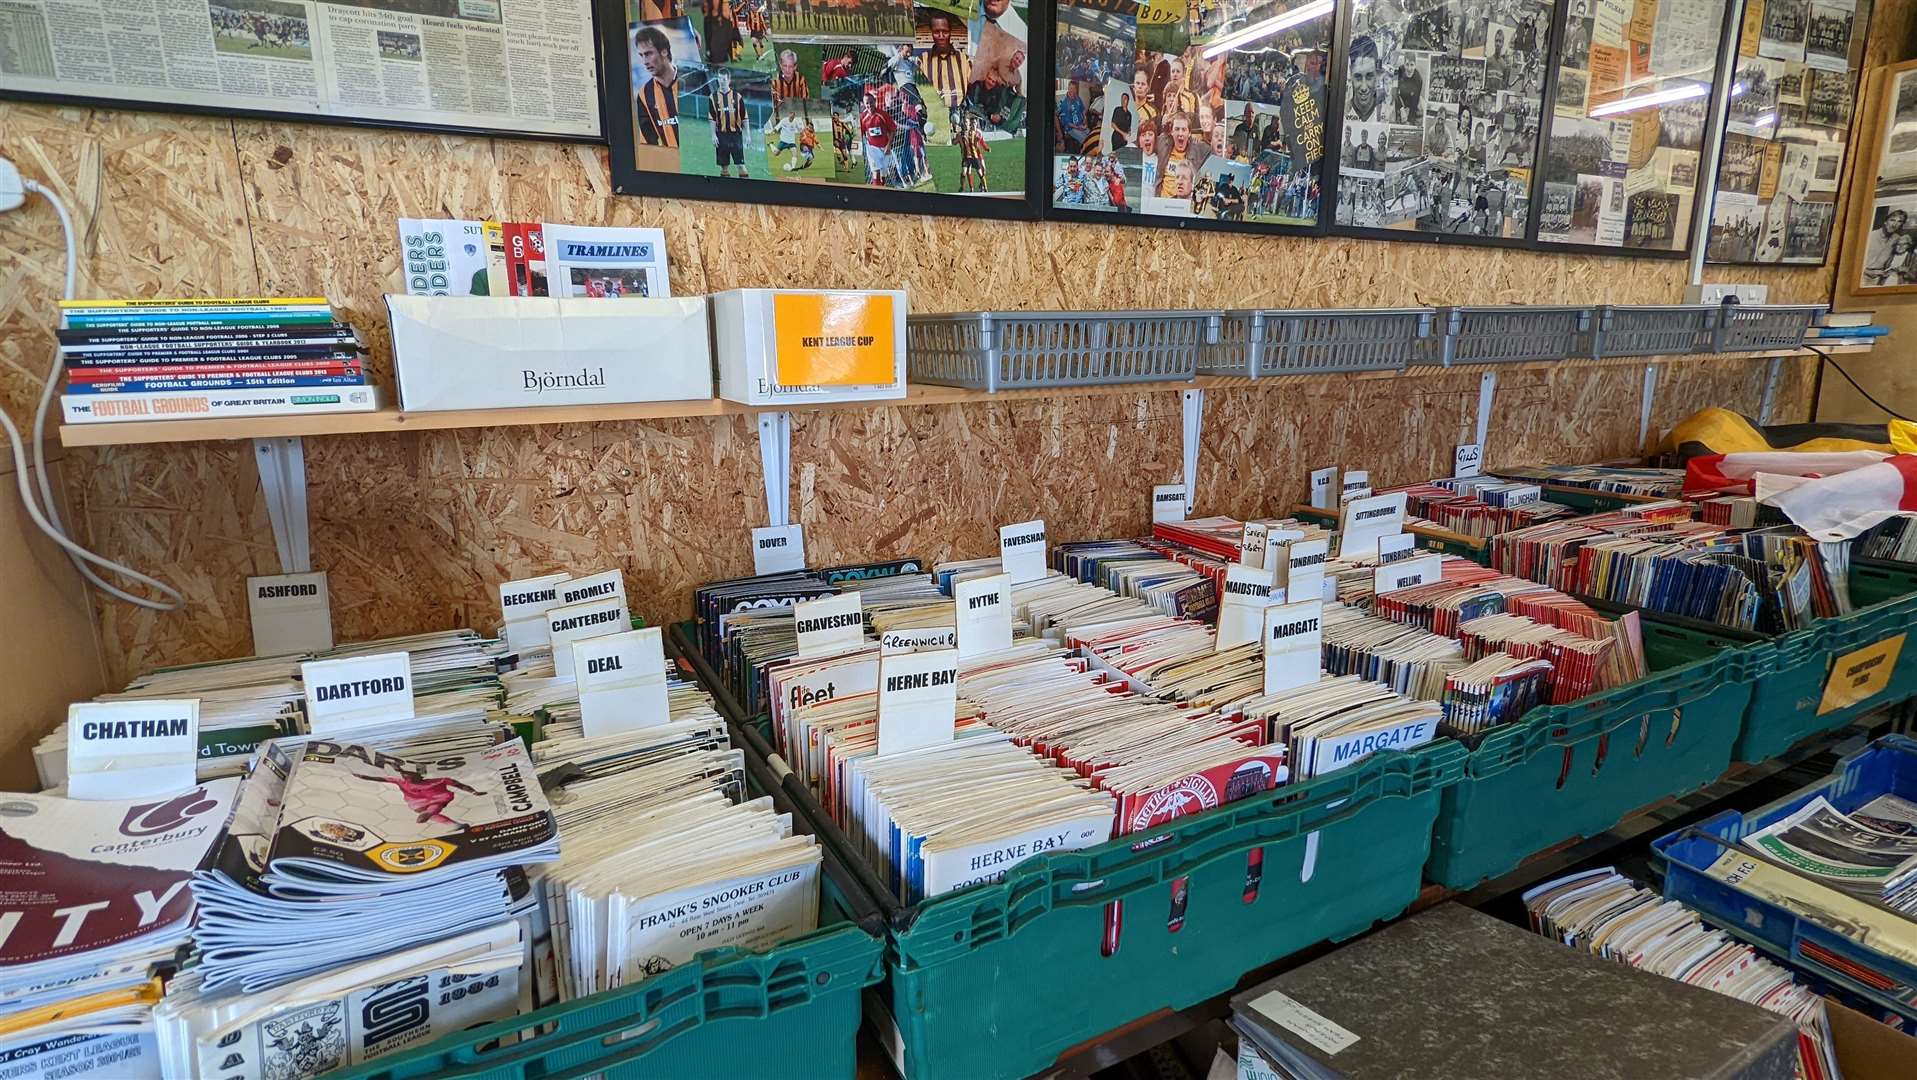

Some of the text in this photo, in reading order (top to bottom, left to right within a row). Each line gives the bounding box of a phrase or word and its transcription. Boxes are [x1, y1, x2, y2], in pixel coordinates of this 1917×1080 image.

[337, 16, 353, 27] cap
[422, 18, 500, 34] Heard feels vindicated
[1293, 99, 1316, 118] KEEP
[1294, 107, 1320, 128] CALM
[1296, 121, 1325, 145] CARRY
[1305, 138, 1320, 151] ON
[566, 244, 649, 257] TRAMLINES
[801, 335, 875, 348] KENT LEAGUE CUP
[191, 379, 232, 387] GROUNDS
[521, 366, 606, 393] Björndal
[92, 398, 151, 417] FOOTBALL
[152, 397, 210, 415] GROUNDS
[224, 399, 251, 407] GREAT
[253, 398, 286, 406] BRITAIN
[1156, 493, 1186, 502] RAMSGATE
[1355, 505, 1397, 521] SITTINGBOURNE
[758, 537, 788, 549] DOVER
[1289, 552, 1327, 569] TONBRIDGE
[1381, 547, 1415, 564] TUNBRIDGE
[257, 582, 318, 599] ASHFORD
[1224, 580, 1272, 598] MAIDSTONE
[1397, 574, 1422, 589] WELLING
[503, 589, 557, 607] BECKENH
[564, 581, 616, 603] BROMLEY
[968, 592, 1000, 610] HYTHE
[796, 612, 862, 634] GRAVESEND
[1273, 617, 1319, 640] MARGATE
[882, 634, 942, 649] GREENWICH
[587, 655, 623, 675] DEAL
[315, 675, 405, 702] DARTFORD
[887, 668, 957, 692] HERNE BAY
[82, 718, 189, 741] CHATHAM
[1333, 722, 1428, 763] MARGATE
[304, 740, 467, 776] DARTS
[499, 762, 533, 812] CAMPBELL
[90, 825, 208, 854] Canterbury
[970, 830, 1072, 871] HERNE BAY
[639, 901, 698, 931] FRANK'S
[702, 881, 764, 910] SNOOKER
[768, 870, 801, 888] CLUB
[679, 925, 703, 938] OPEN
[712, 914, 733, 927] DAYS
[742, 903, 764, 917] WEEK
[695, 933, 706, 941] 10
[707, 929, 719, 937] am
[726, 922, 735, 930] 11
[737, 917, 750, 928] pm
[438, 976, 500, 1006] 1984
[386, 1024, 431, 1044] SOUTHERN
[14, 1045, 41, 1060] Cray
[363, 1029, 431, 1061] FOOTBALL LEAGUE
[363, 1044, 381, 1055] THE
[44, 1058, 95, 1080] SEASON
